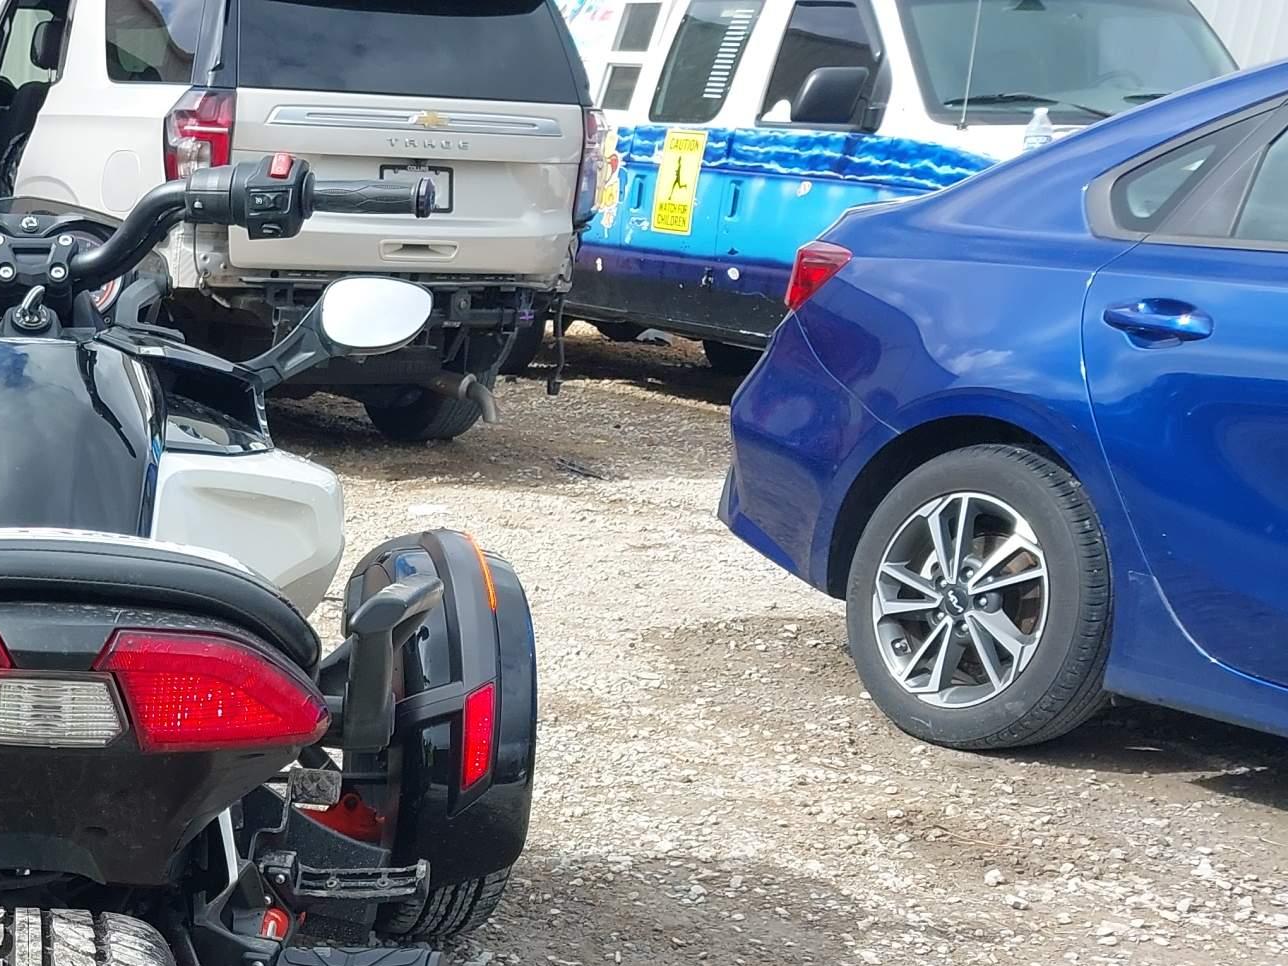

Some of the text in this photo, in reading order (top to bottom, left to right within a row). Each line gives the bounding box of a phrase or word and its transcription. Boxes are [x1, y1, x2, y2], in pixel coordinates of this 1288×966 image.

[386, 138, 470, 150] TAHOE
[669, 137, 700, 152] CAUTION
[658, 203, 688, 215] WATCH FOR
[656, 213, 687, 228] CHILDREN
